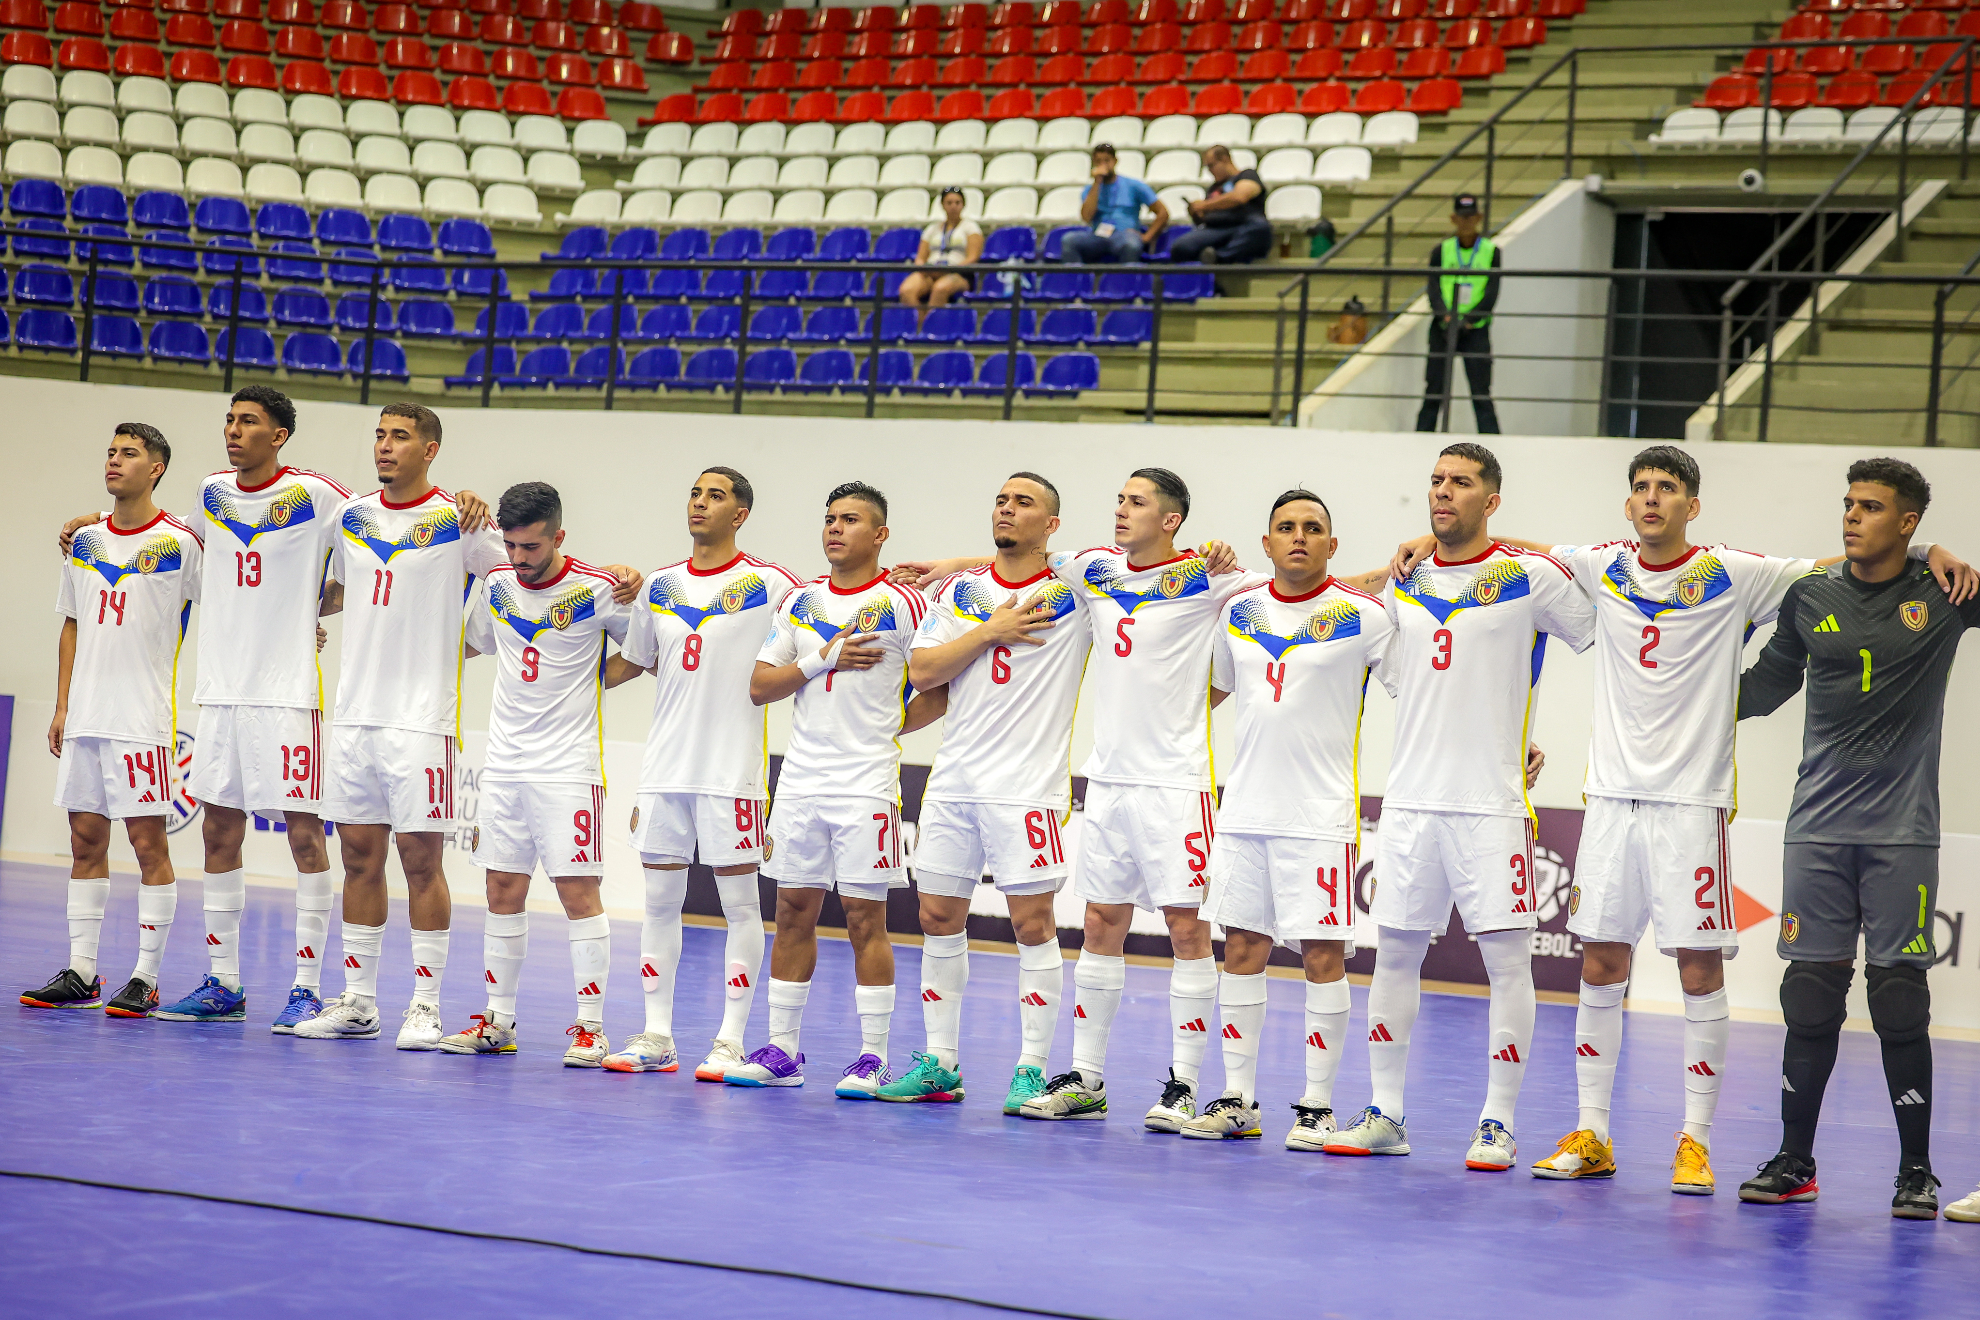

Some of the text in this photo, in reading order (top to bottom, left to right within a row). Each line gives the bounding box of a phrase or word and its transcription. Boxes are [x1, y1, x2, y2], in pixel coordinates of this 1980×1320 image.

[235, 551, 262, 588] 13
[372, 569, 393, 606] 11
[98, 590, 127, 626] 14
[682, 633, 702, 672] 8
[1115, 617, 1136, 658] 5
[1432, 628, 1453, 671] 3
[1640, 625, 1660, 669] 2
[521, 647, 540, 683] 9
[991, 645, 1011, 685] 6
[1266, 662, 1286, 703] 4
[1859, 648, 1872, 693] 1
[123, 751, 156, 789] 14
[281, 745, 311, 782] 13
[425, 767, 445, 804] 11
[574, 810, 592, 847] 9
[735, 798, 753, 832] 8
[872, 813, 889, 852] 7
[1025, 810, 1047, 850] 6
[1184, 831, 1207, 873] 5
[1318, 866, 1338, 908] 4
[1510, 853, 1527, 896] 3
[1694, 867, 1715, 910] 2
[1917, 884, 1928, 929] 1
